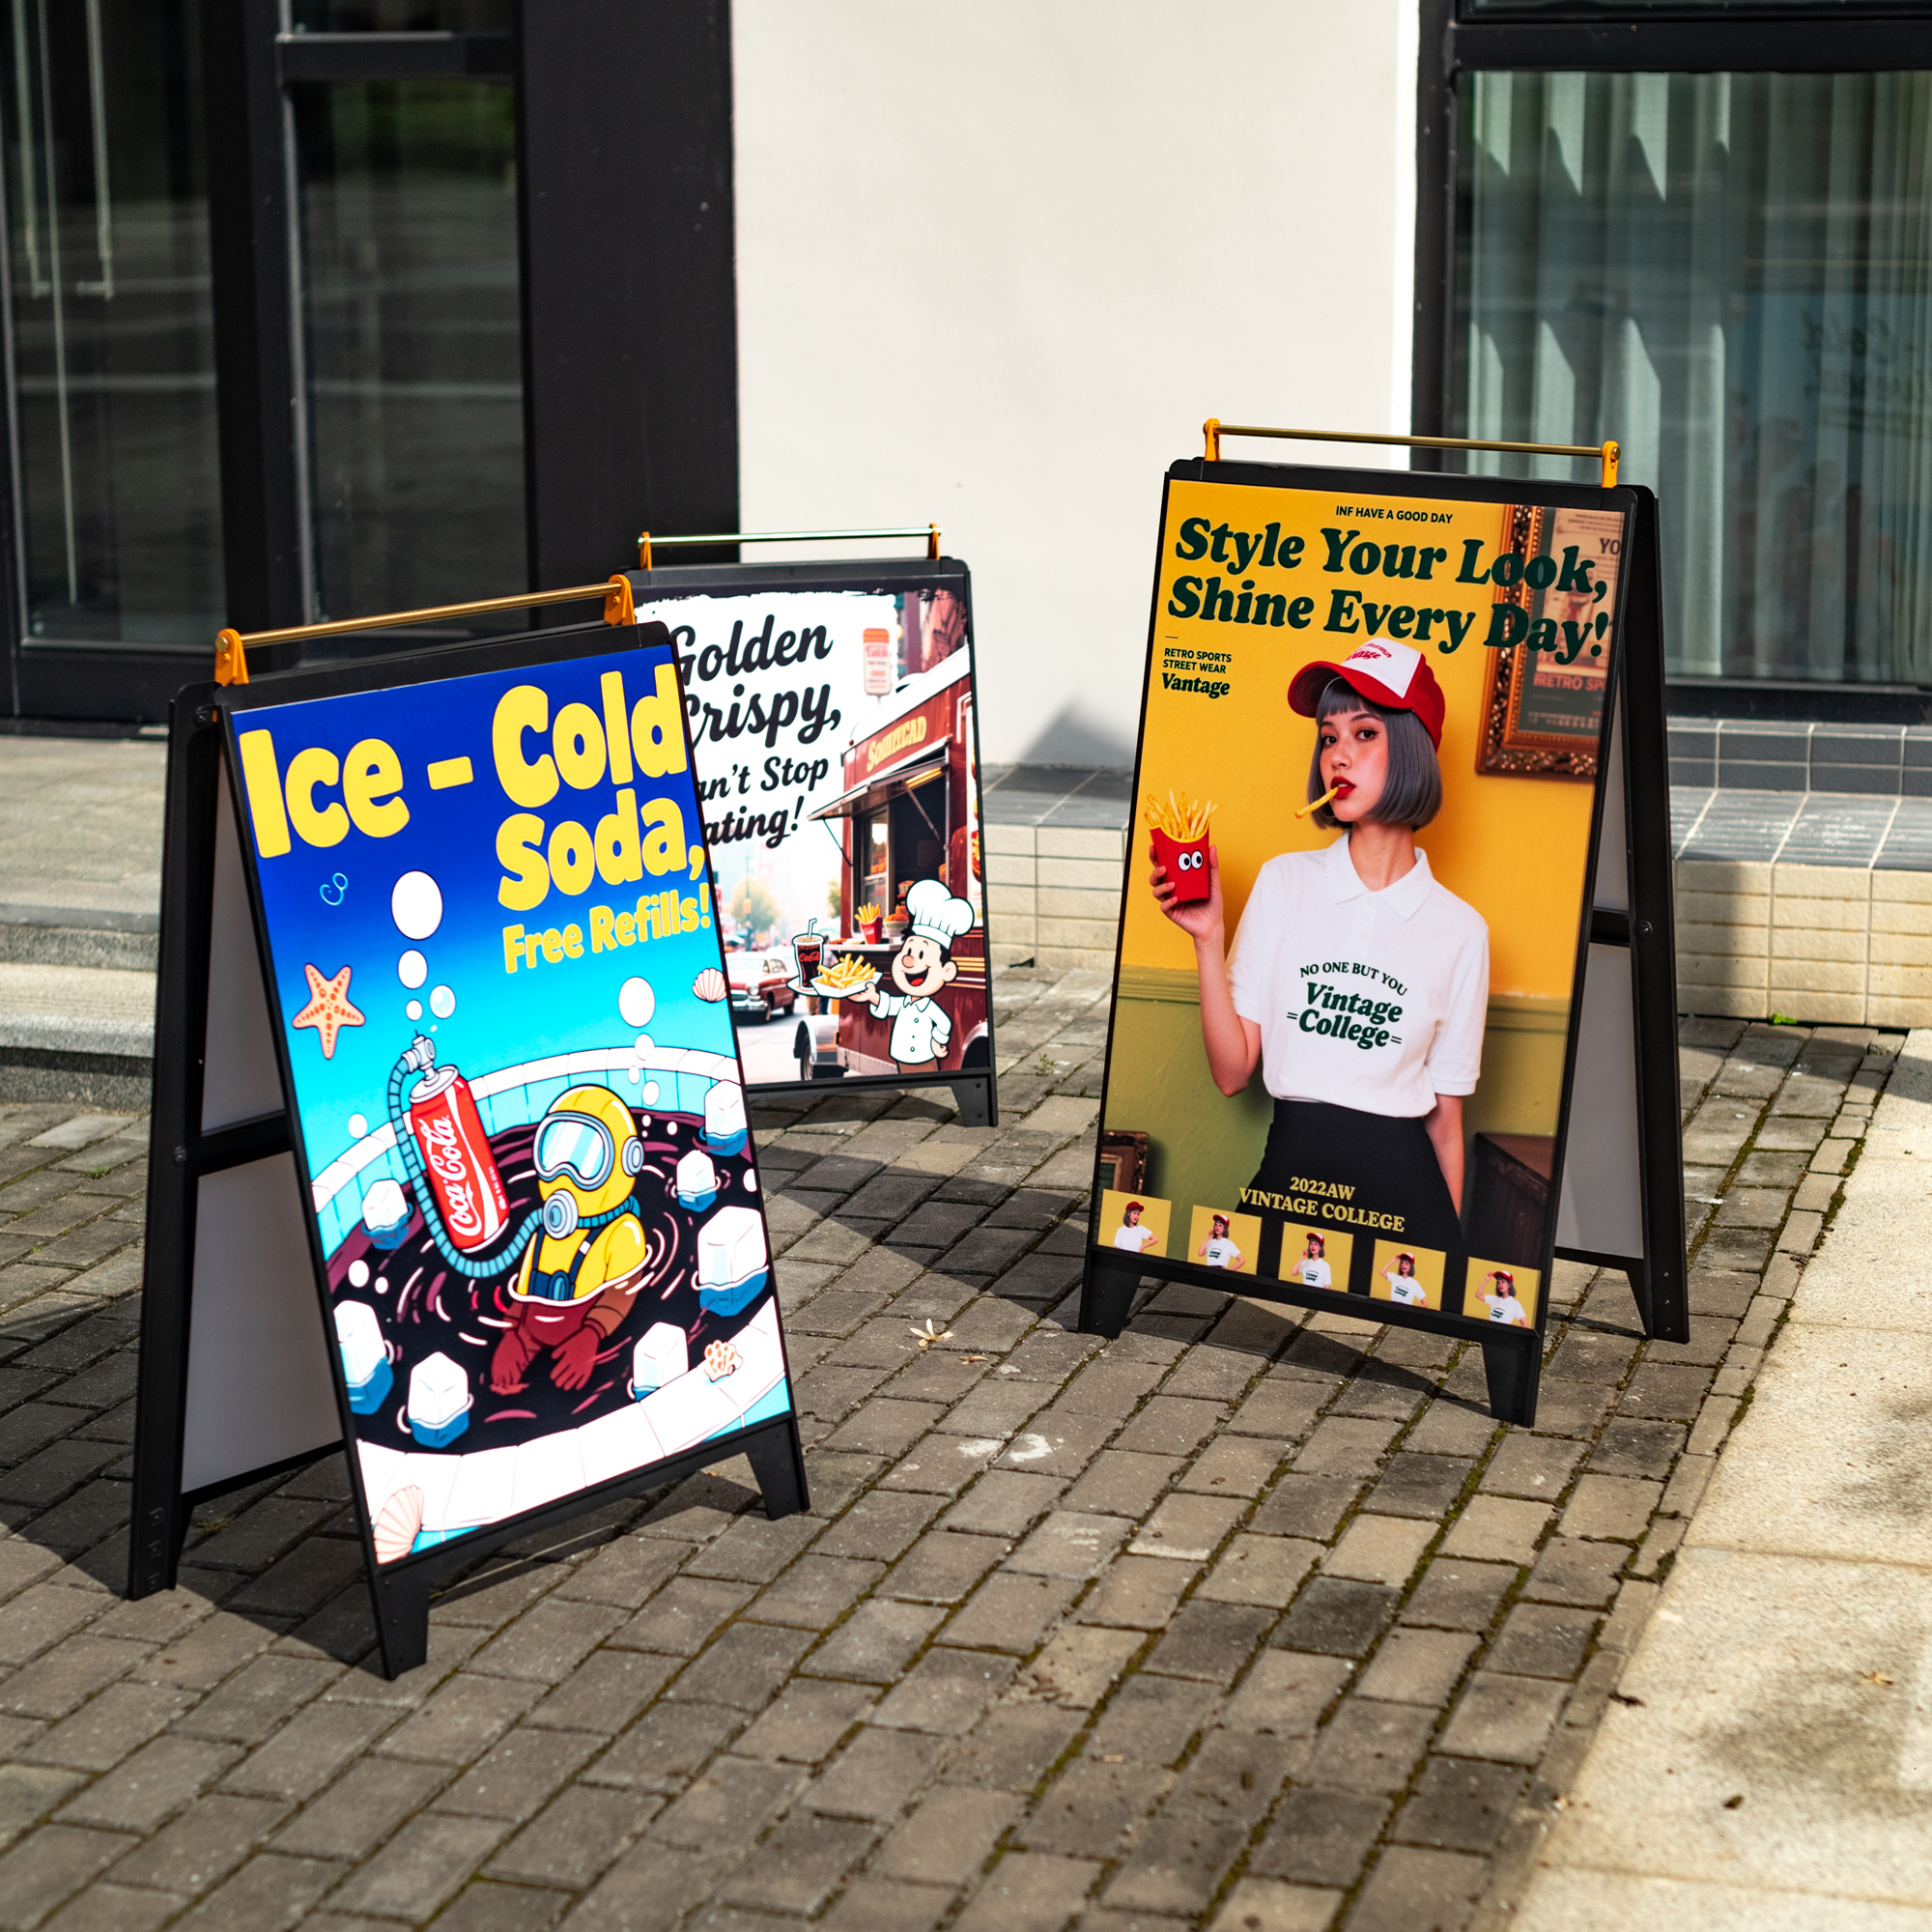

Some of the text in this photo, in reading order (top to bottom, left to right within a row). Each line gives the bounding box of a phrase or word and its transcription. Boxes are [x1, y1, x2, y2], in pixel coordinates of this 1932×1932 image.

[1336, 505, 1453, 524] INF HAVE A GOOD DAY
[1176, 517, 1607, 604] Style Your Look,
[1168, 575, 1607, 666] Shine Every Day!
[670, 614, 834, 686] Golden
[1163, 659, 1226, 673] STREET WEAR
[1164, 647, 1232, 663] RETRO SPORTS
[1161, 672, 1230, 699] Vantage
[239, 728, 411, 858] Ice
[492, 664, 688, 808] Cold
[697, 755, 829, 802] an't Stop
[704, 795, 805, 849] ating!
[496, 788, 705, 911] Soda,
[503, 883, 711, 974] Free Refills!
[1299, 962, 1407, 996] NO ONE BUT YOU
[1307, 981, 1403, 1025] Vintage
[1238, 1187, 1406, 1233] VINTAGE COLLEGE
[1290, 1177, 1355, 1201] 2022AW
